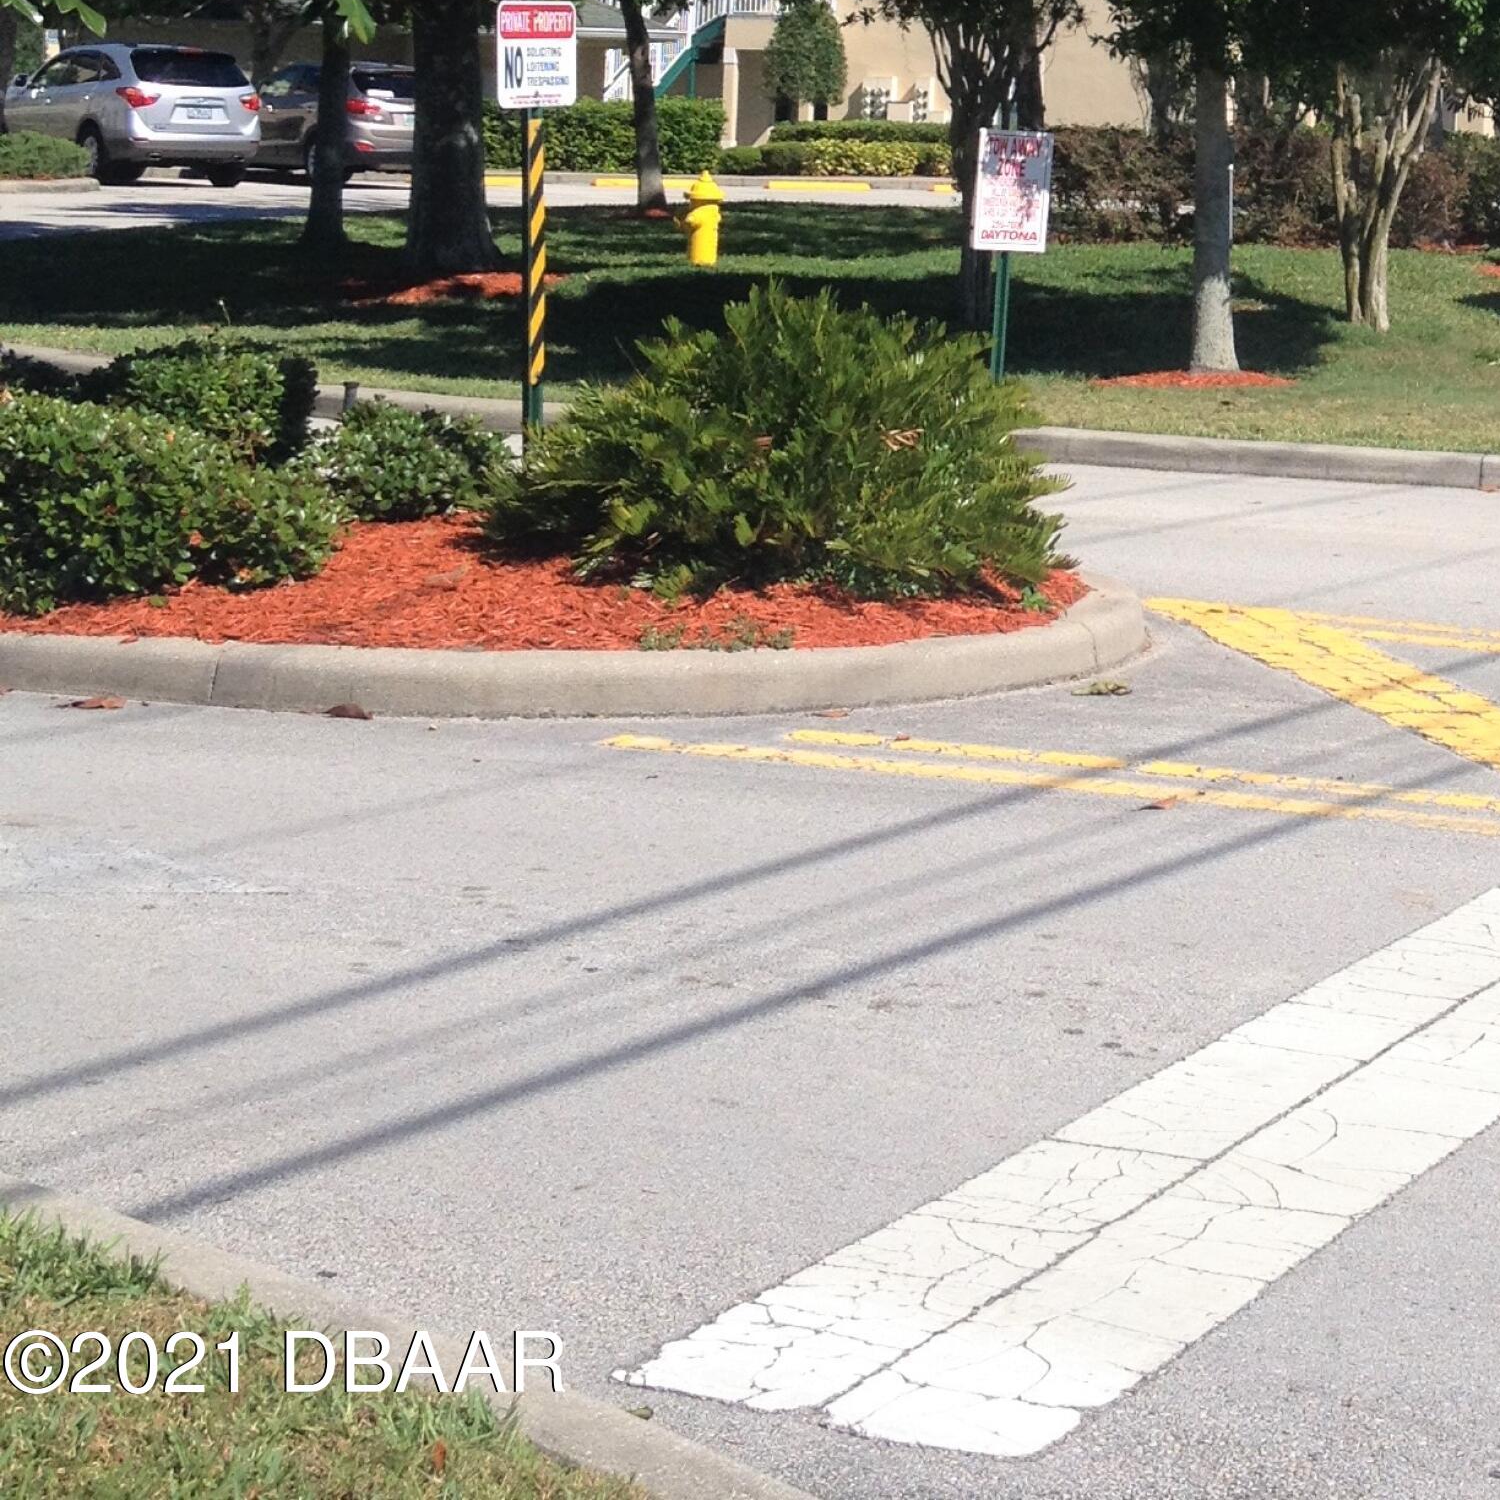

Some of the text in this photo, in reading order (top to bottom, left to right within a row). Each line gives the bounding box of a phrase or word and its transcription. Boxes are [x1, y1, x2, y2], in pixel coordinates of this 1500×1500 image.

[501, 11, 572, 32] PRIVATE PROPERTY
[504, 46, 523, 89] NO
[989, 137, 1042, 157] TOW AWAY
[997, 158, 1026, 179] ZONE
[981, 229, 1037, 240] DAYTONA
